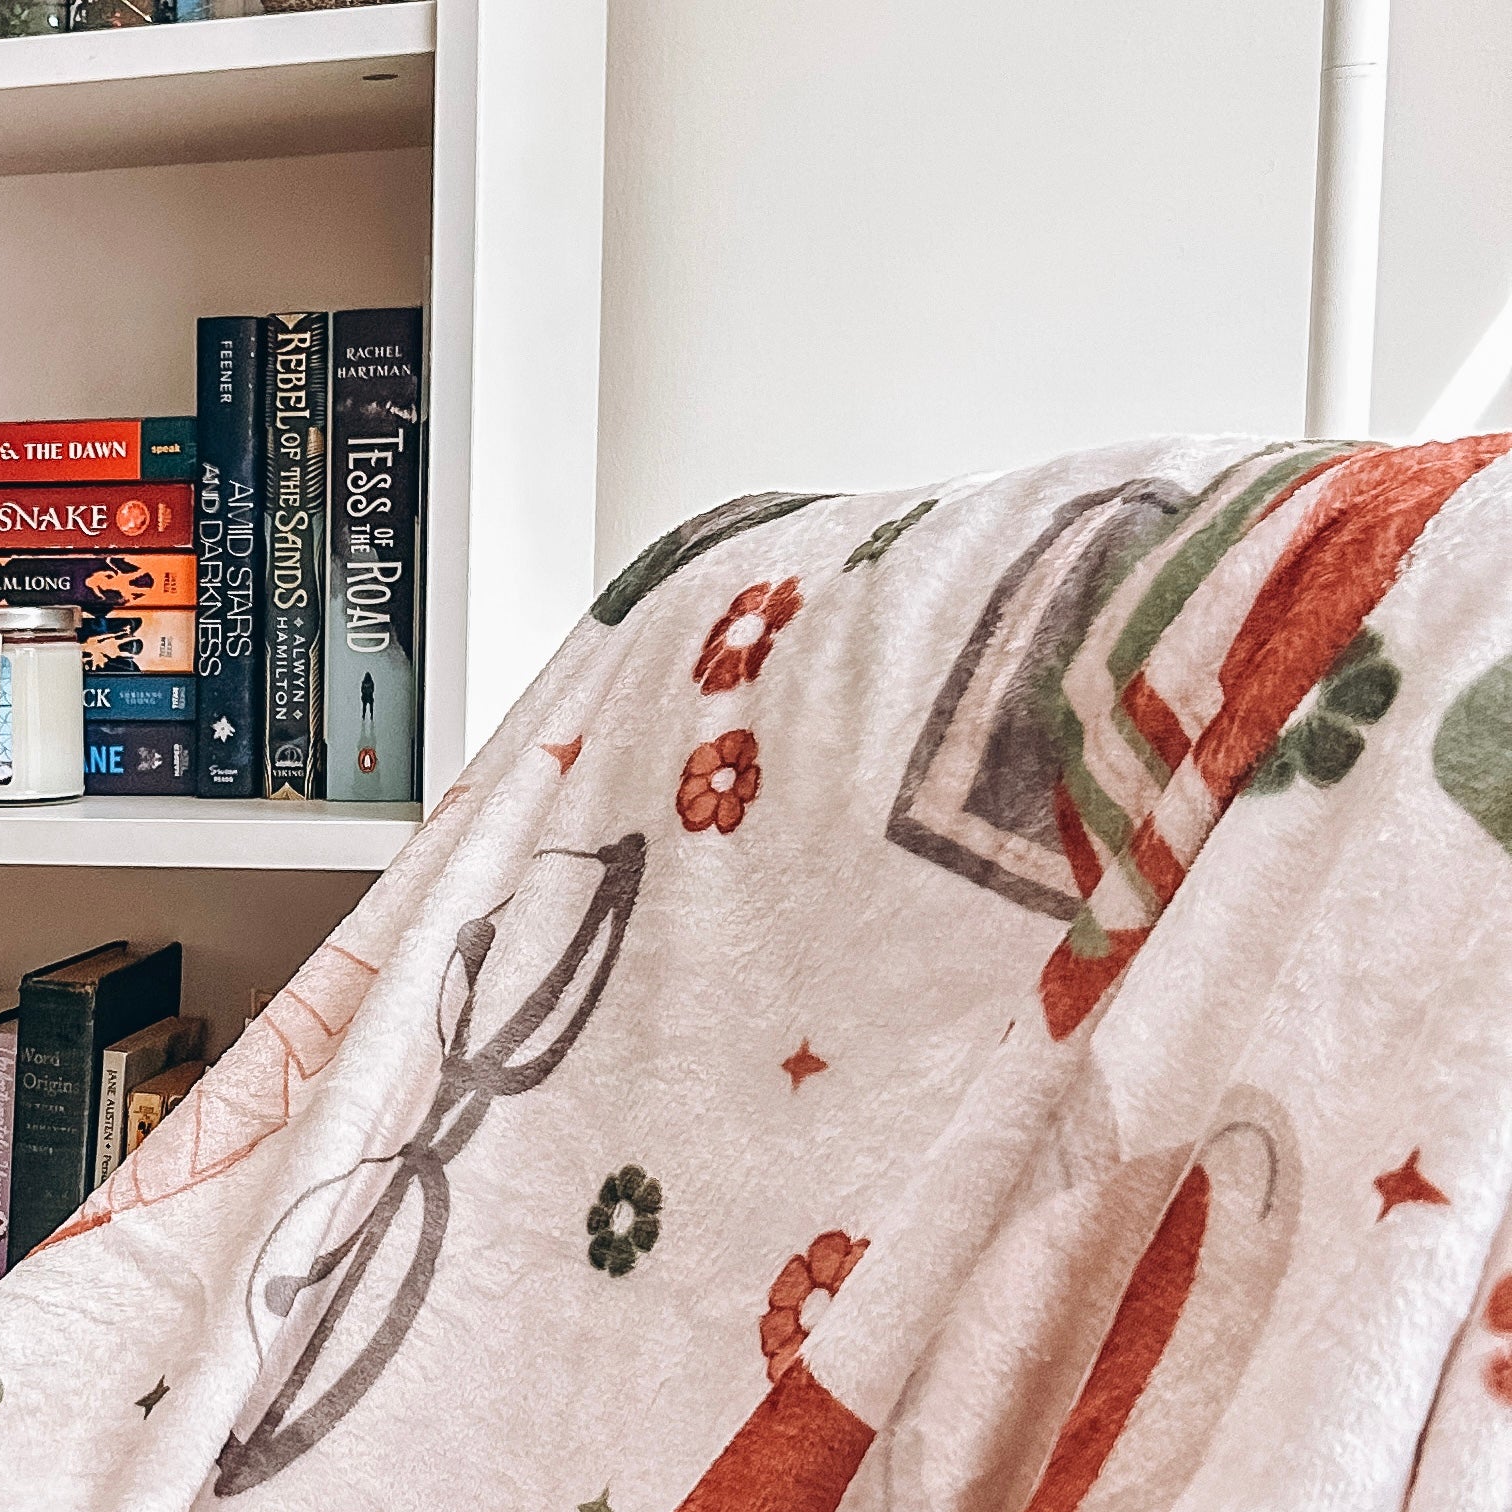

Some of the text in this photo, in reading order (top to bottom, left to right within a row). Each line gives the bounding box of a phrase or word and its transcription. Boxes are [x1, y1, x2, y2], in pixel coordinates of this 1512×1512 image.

[219, 340, 233, 403] FEENER
[338, 364, 411, 380] HARTMAN
[346, 345, 403, 361] RACHEL
[24, 442, 63, 460] THE
[68, 440, 127, 459] DAWN
[150, 443, 181, 455] speak
[272, 331, 311, 610] REBEL OF THE SANDS
[346, 427, 404, 653] TESS OF THE ROAD
[25, 576, 71, 592] LONG
[198, 461, 224, 677] AND DARKNESS
[225, 479, 254, 658] AMID STARS
[275, 616, 289, 720] HAMILTON
[292, 634, 306, 703] ALWYN
[273, 769, 304, 778] VIKING
[20, 1047, 61, 1067] Word
[22, 1072, 81, 1098] Origins
[103, 1069, 118, 1148] JANE AUSTEN
